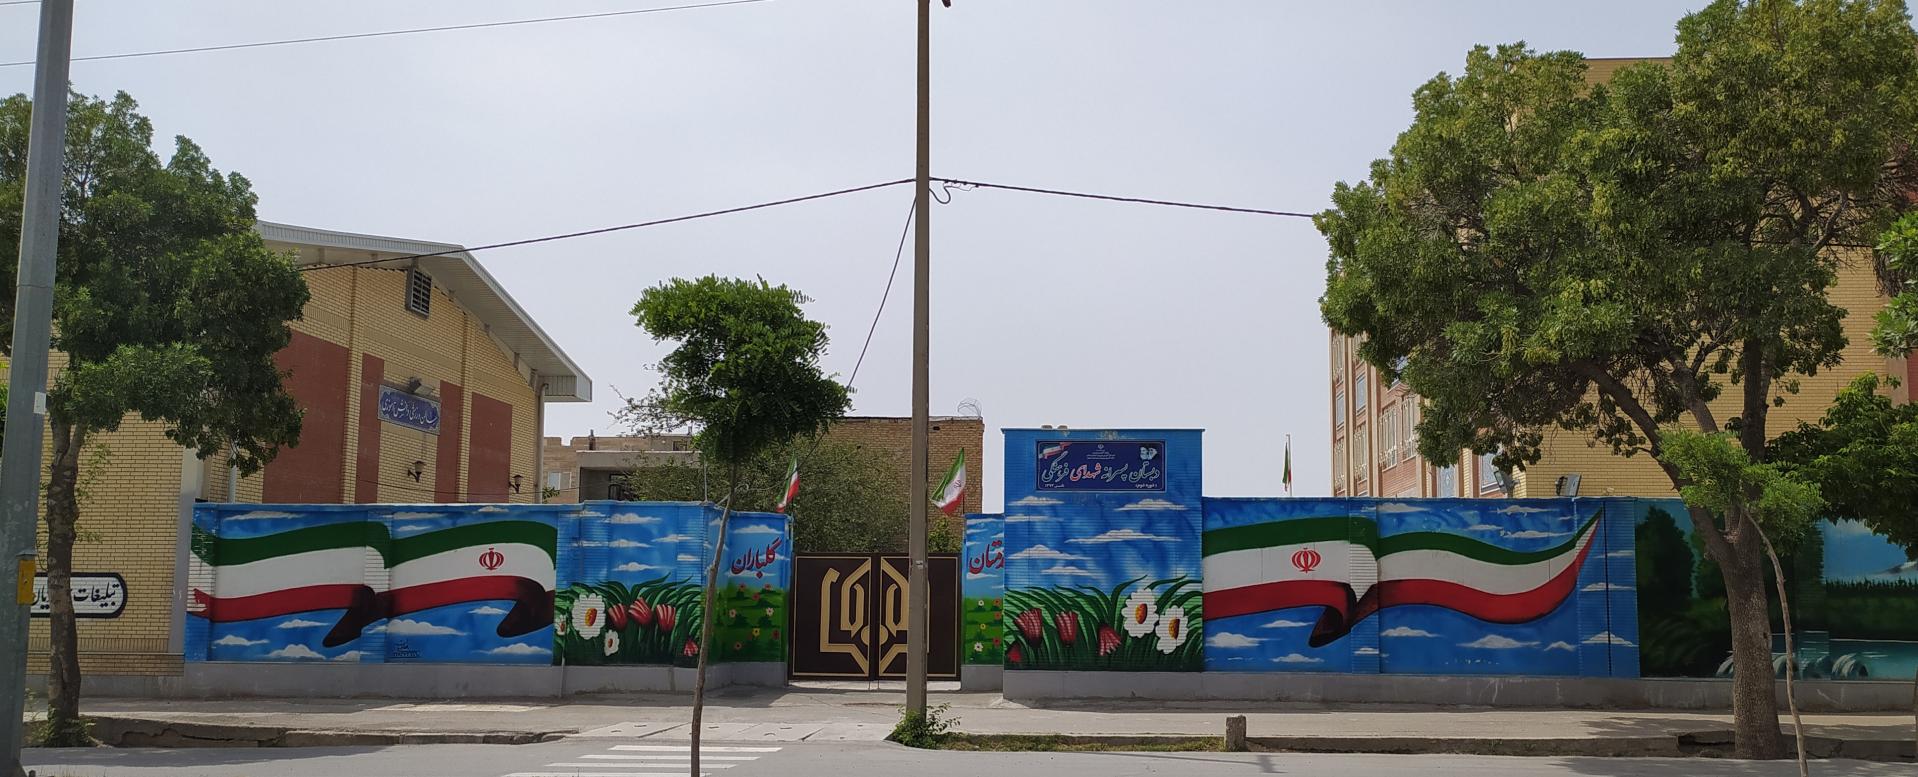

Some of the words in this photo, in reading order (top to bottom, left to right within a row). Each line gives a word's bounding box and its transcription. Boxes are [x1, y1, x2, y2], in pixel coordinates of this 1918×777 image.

[1042, 451, 1069, 482] فرهنگی
[1070, 462, 1101, 481] شهدای
[1101, 463, 1128, 482] پسرانه
[1129, 461, 1160, 482] دبستان
[731, 536, 782, 579] گلباران
[73, 582, 120, 608] تبلیغات
